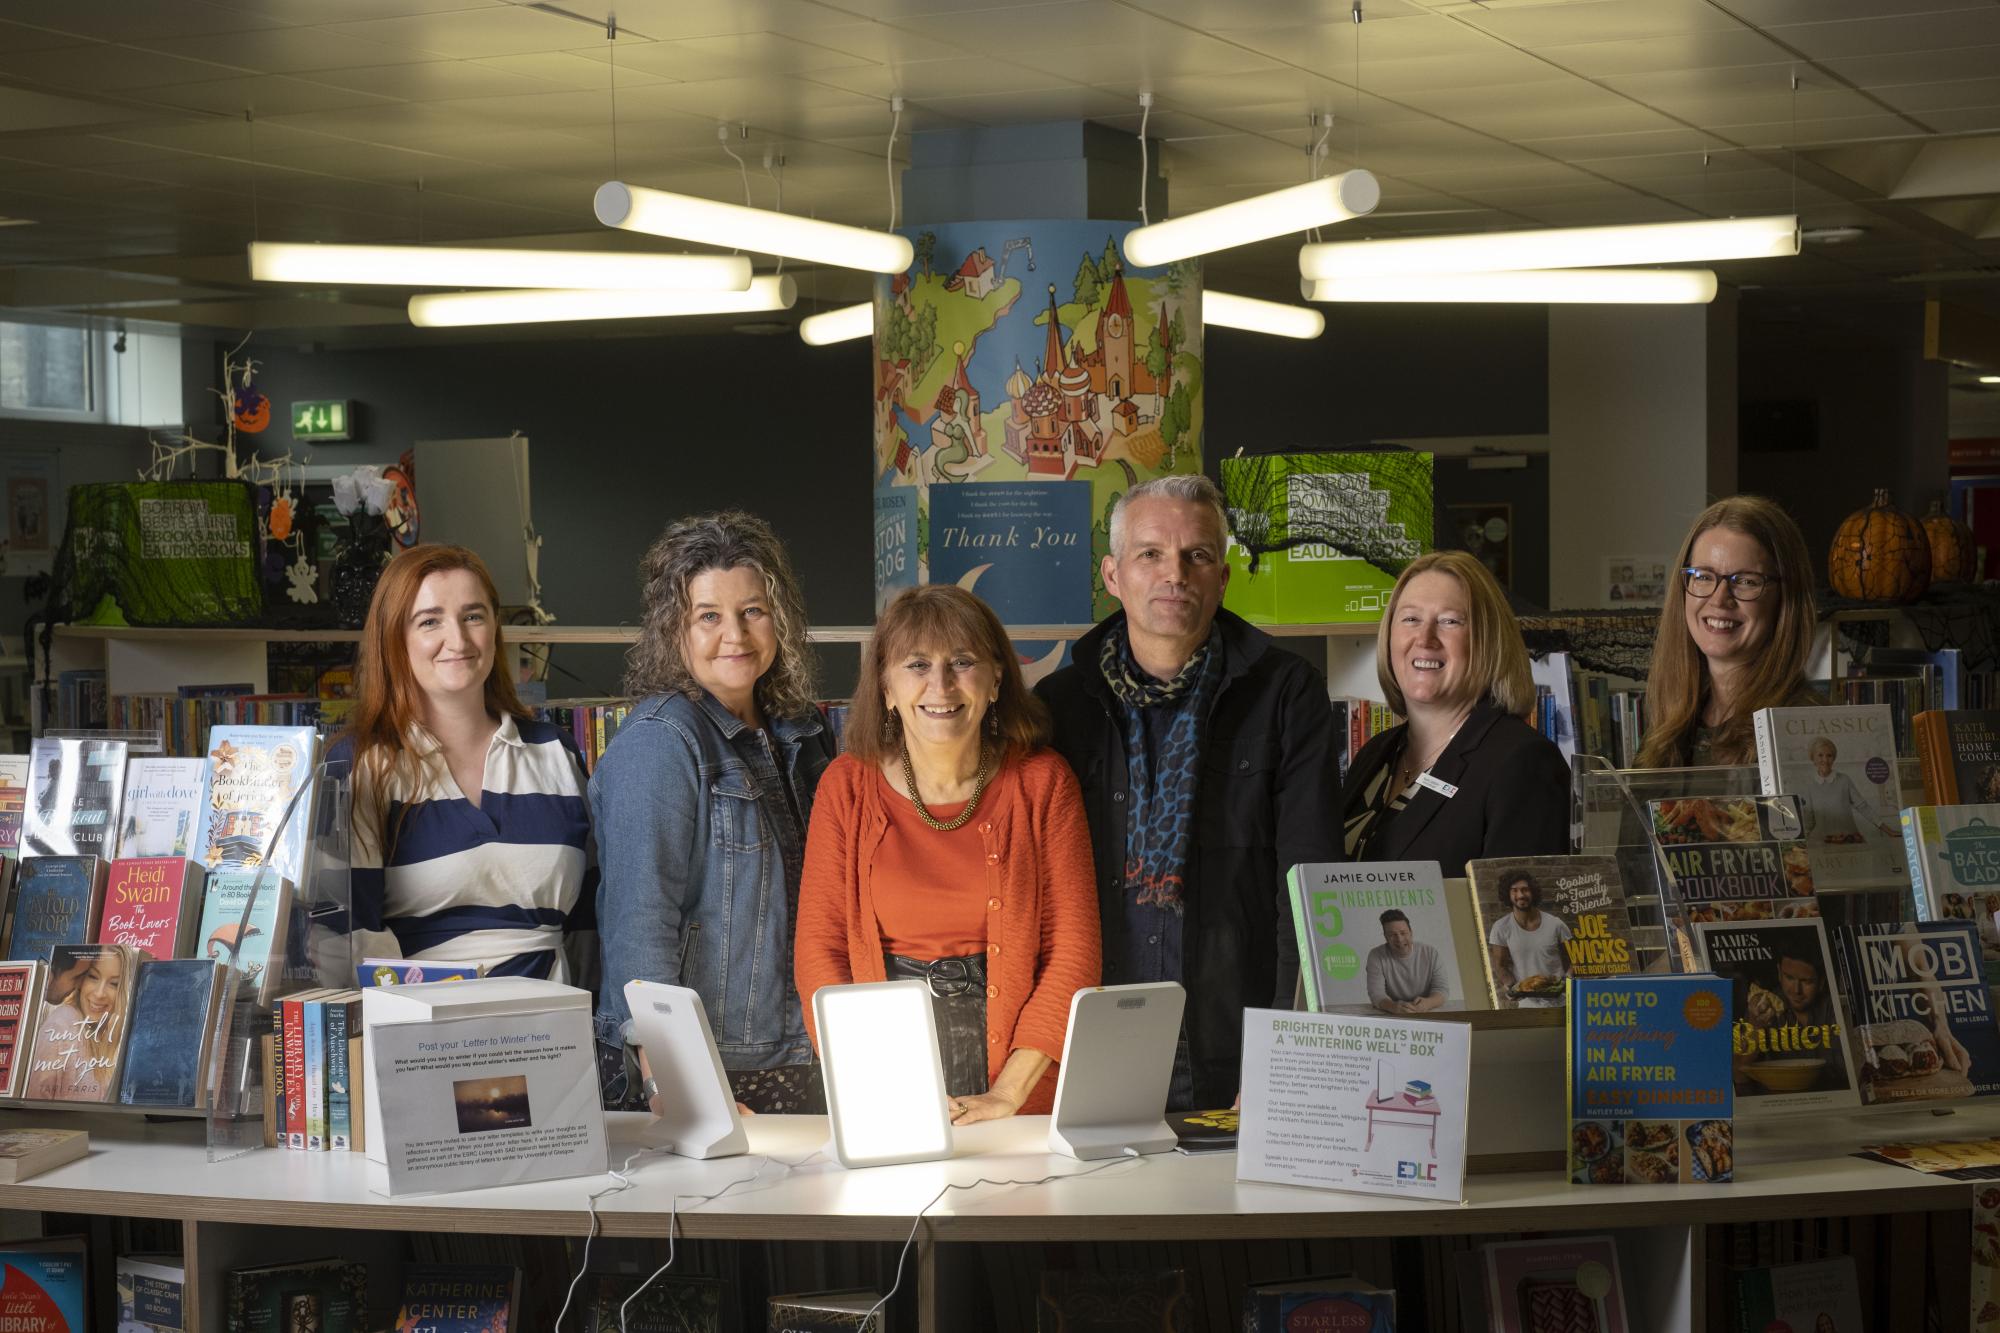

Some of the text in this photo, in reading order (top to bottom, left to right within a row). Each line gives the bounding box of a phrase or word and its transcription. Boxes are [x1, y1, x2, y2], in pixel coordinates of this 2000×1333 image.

[943, 525, 1078, 549] Thank You
[1367, 525, 1404, 540] AND
[1786, 716, 1880, 735] CLASSIC
[1954, 721, 1986, 732] KATE
[1956, 731, 2000, 742] HUMBL
[1957, 743, 1992, 752] HOME
[1959, 752, 2000, 761] COOKE
[128, 785, 148, 801] girl
[166, 784, 197, 799] dove
[73, 832, 103, 842] CLUB
[1669, 847, 1777, 877] AIR FRYER
[1905, 838, 1921, 889] BATCH
[1954, 850, 2000, 867] BATC
[128, 865, 165, 883] Heidi
[1324, 872, 1416, 883] JAMIE OLIVER
[1556, 873, 1602, 890] Cooking
[115, 880, 170, 904] Swain
[1555, 884, 1608, 902] for Family
[1669, 875, 1783, 901] COOKBOOK
[132, 904, 145, 915] The
[1312, 889, 1435, 937] 5 INGREDIENTS
[1570, 896, 1612, 914] Friends
[1573, 914, 1612, 939] JOE
[115, 932, 161, 948] Retreat
[1711, 934, 1760, 948] JAMES
[1563, 938, 1631, 964] WICKS
[1714, 946, 1773, 962] MARTIN
[1573, 964, 1632, 974] THE BODY COACH
[1870, 942, 1967, 979] MOB
[14, 978, 25, 991] IN
[1586, 992, 1658, 1007] HOW TO
[1870, 988, 1987, 1020] KITCHEN
[0, 1004, 19, 1016] RGINS
[1587, 1010, 1637, 1026] MAKE
[44, 1011, 120, 1043] until I
[1272, 1020, 1443, 1044] BRIGHTEN YOUR DAYS WITH
[418, 1042, 438, 1051] Post
[440, 1041, 458, 1051] your
[531, 1033, 550, 1042] here
[1275, 1033, 1284, 1045] A
[1410, 1044, 1436, 1056] BOX
[1587, 1025, 1679, 1051] anything
[1733, 1018, 1841, 1056] Butter
[272, 1009, 284, 1097] THE WILD BOOK
[284, 1022, 296, 1095] UNWRITTEN
[294, 1026, 304, 1079] LIBRARY
[330, 1033, 338, 1075] Auschwitz
[1587, 1048, 1635, 1063] IN AN
[33, 1044, 80, 1071] met
[75, 1054, 116, 1086] you
[1586, 1066, 1676, 1081] AIR FRYER
[67, 1085, 98, 1093] FARIS
[1586, 1088, 1724, 1104] EASY DINNERS!
[1397, 1160, 1438, 1182] EDLC
[144, 1279, 171, 1289] THE STORY
[406, 1282, 505, 1298] KATHERINE
[143, 1287, 164, 1296] CLASSIC
[164, 1290, 180, 1300] CRIME
[4, 1300, 36, 1314] little
[154, 1304, 171, 1314] BOOKS
[409, 1303, 478, 1320] CENTER
[0, 1317, 47, 1333] IBRARY
[1290, 1314, 1367, 1328] STARLESS
